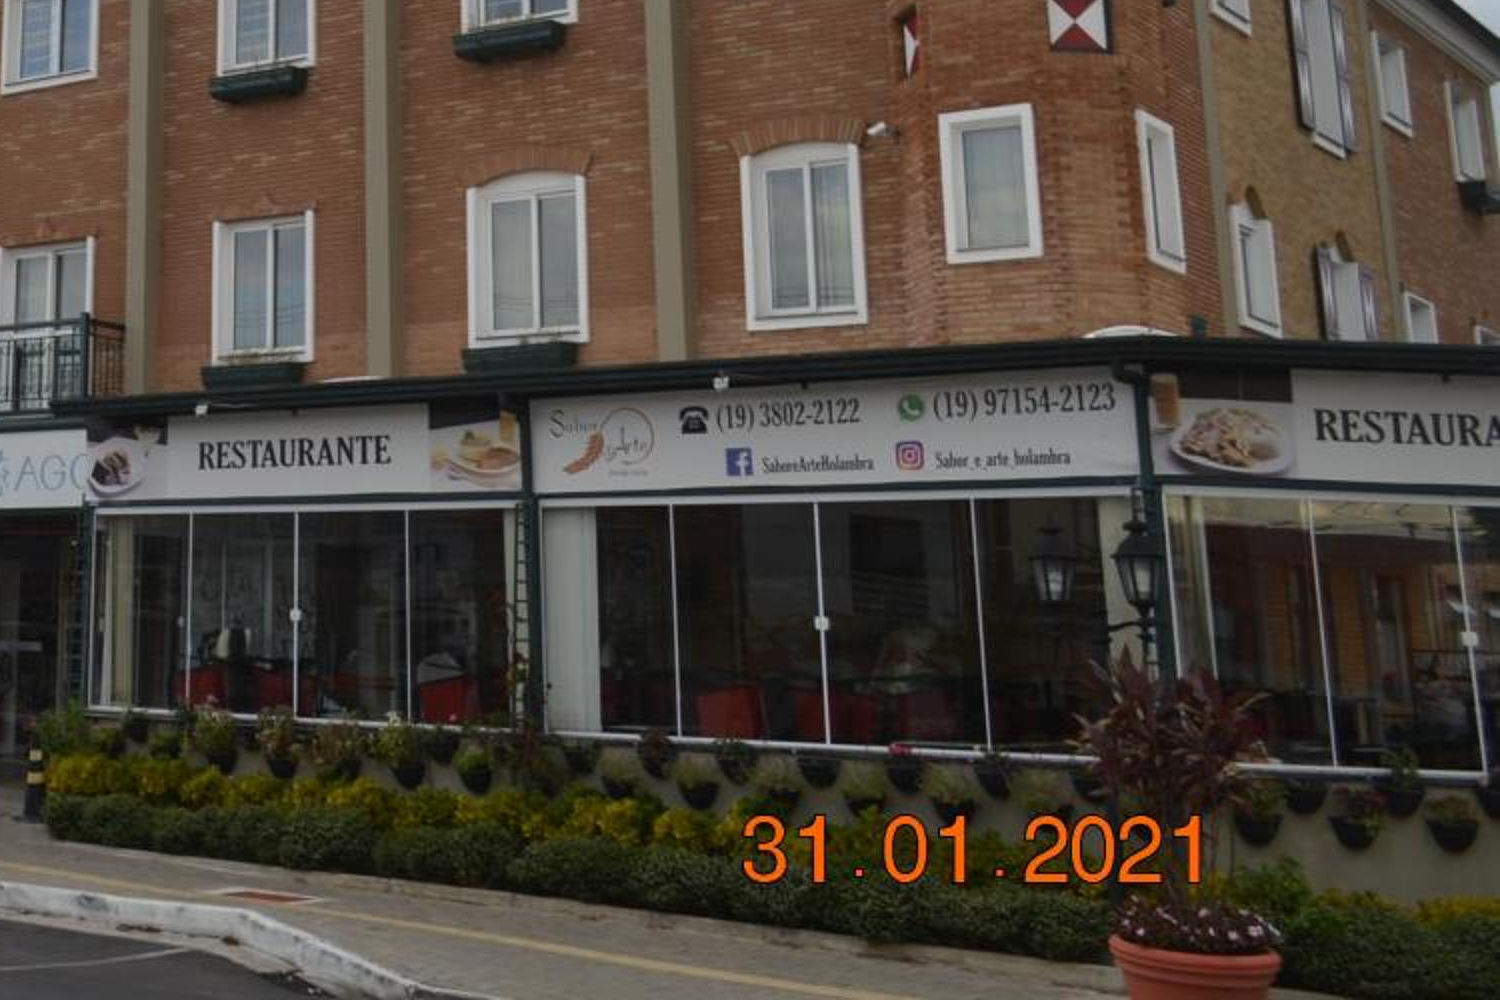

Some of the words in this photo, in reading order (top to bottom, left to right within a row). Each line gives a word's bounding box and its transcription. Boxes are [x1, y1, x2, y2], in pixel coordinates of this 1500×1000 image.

[716, 403, 754, 432] (19)
[759, 397, 861, 428] 3802-2122
[933, 389, 977, 421] (19)
[984, 382, 1116, 416] 97154-2123
[199, 435, 392, 470] RESTAURANTE
